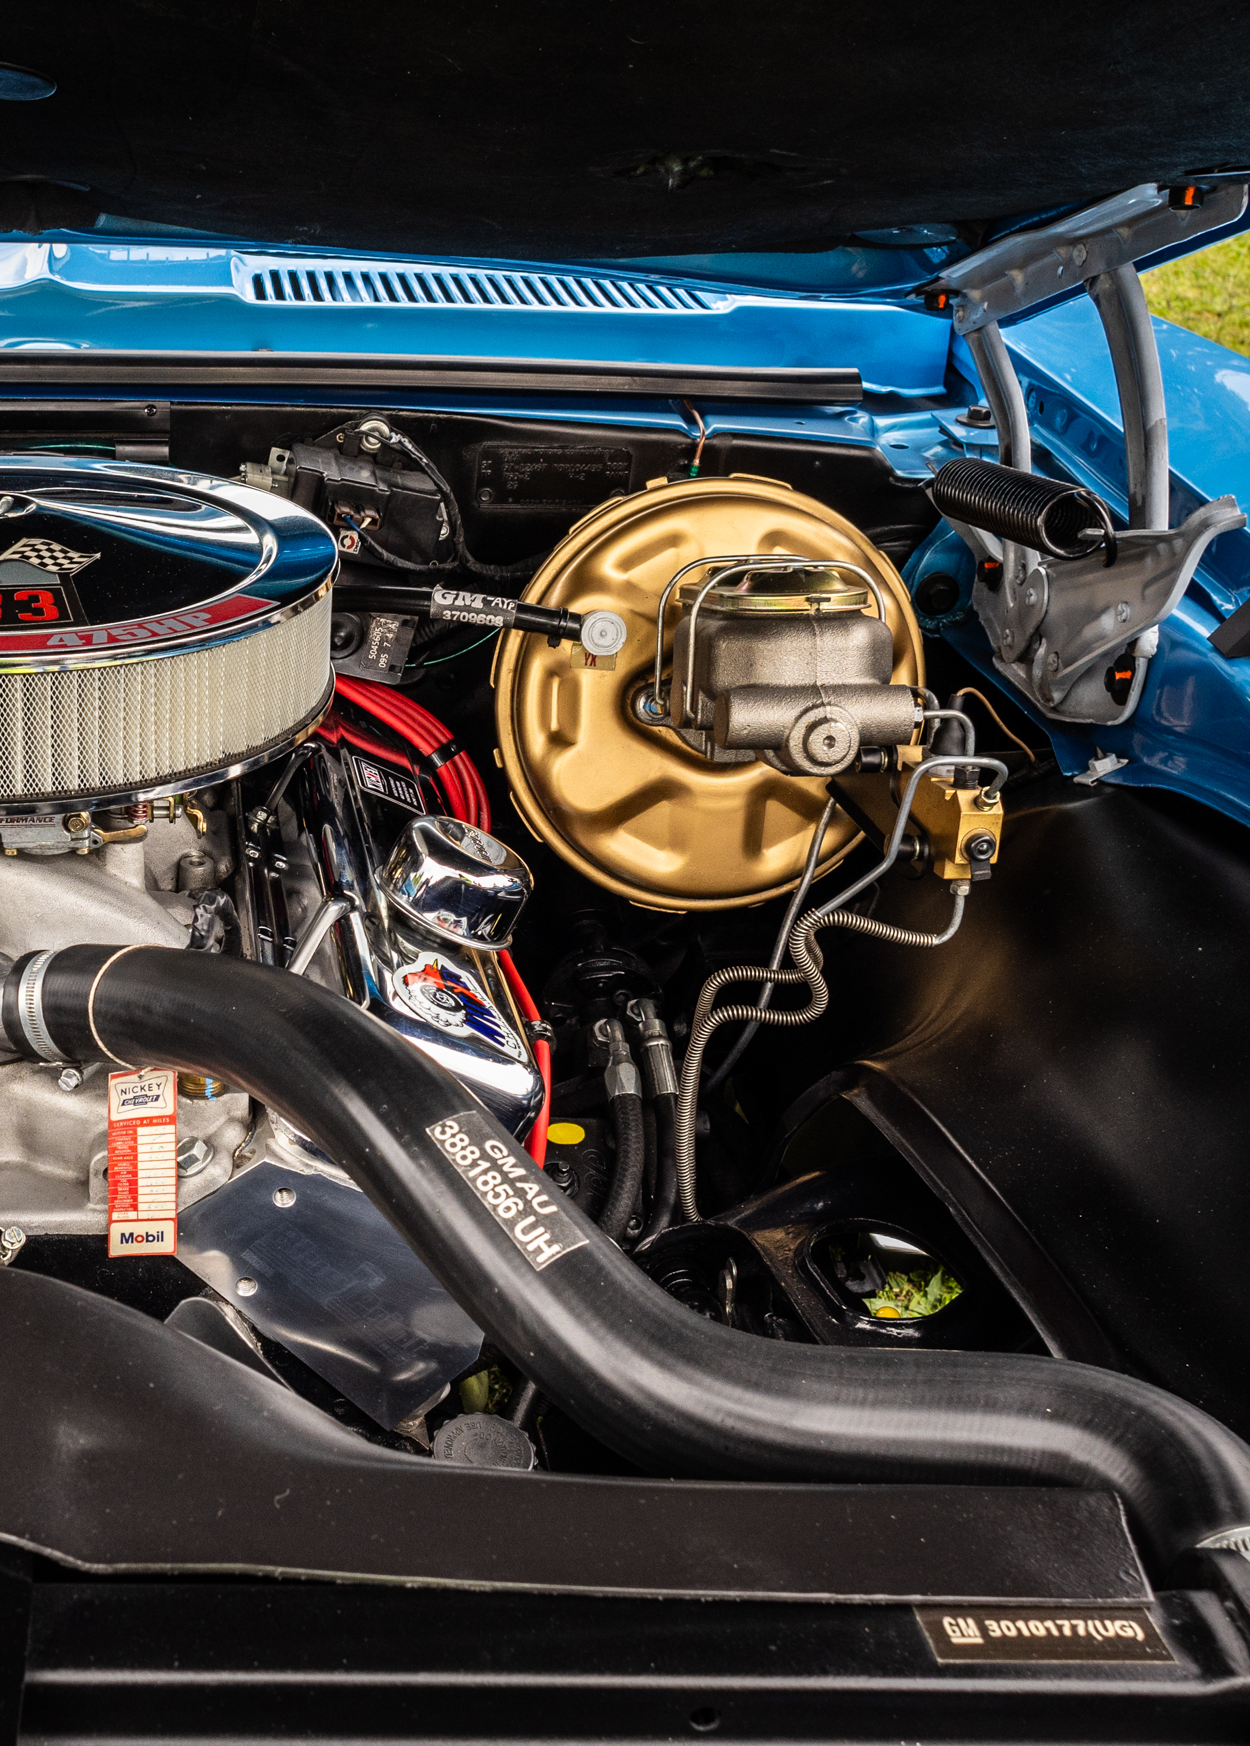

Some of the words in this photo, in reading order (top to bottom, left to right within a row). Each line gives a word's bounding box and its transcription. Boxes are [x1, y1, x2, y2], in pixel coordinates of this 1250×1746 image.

[46, 611, 213, 648] 475HP
[120, 1083, 162, 1096] NICKEY
[434, 1120, 524, 1218] 3881856
[514, 1215, 563, 1263] UH
[485, 1140, 527, 1178] GM
[515, 1181, 558, 1215] AU
[120, 1231, 164, 1245] Mobil
[942, 1616, 984, 1644] GM
[987, 1619, 1145, 1642] 3010177(UG)
